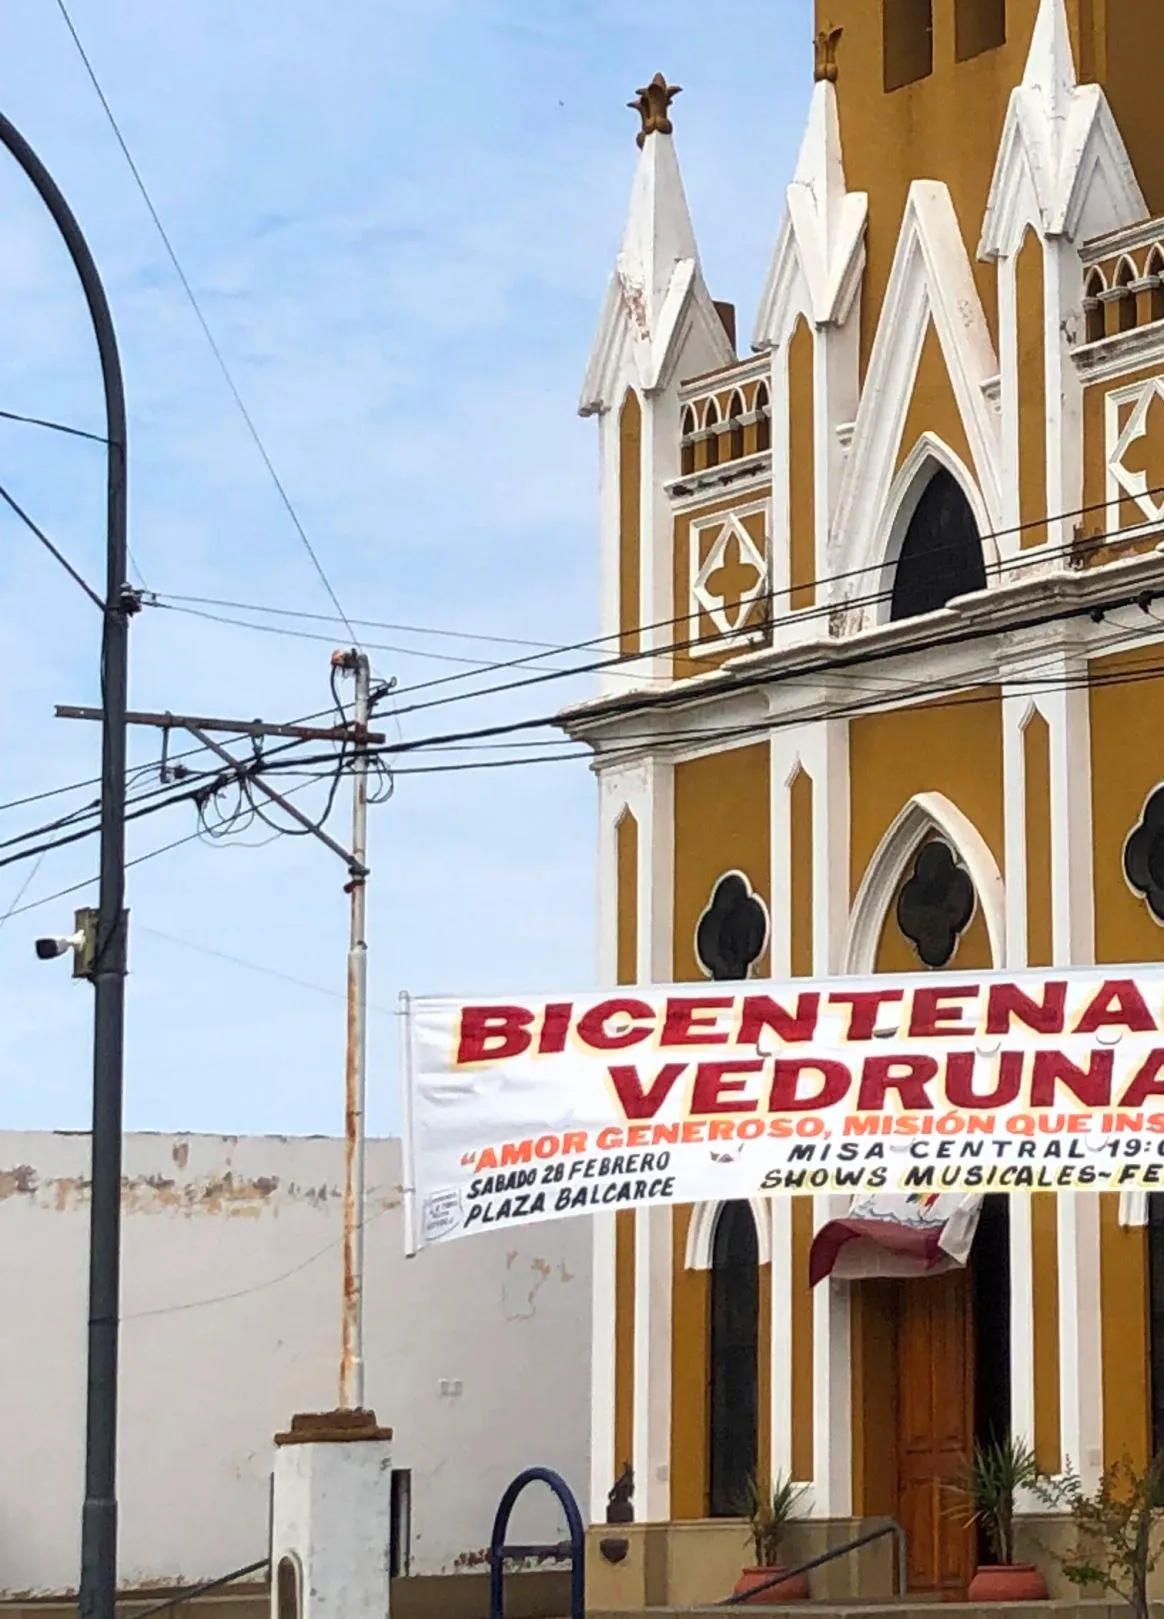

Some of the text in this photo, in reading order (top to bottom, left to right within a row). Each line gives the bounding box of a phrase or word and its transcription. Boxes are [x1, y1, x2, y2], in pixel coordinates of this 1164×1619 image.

[460, 1131, 587, 1173] “AMOR
[596, 1116, 832, 1149] GENEROSO,
[843, 1110, 994, 1136] MISIÓN
[1006, 1113, 1093, 1138] QUE
[787, 1142, 886, 1162] MISA
[910, 1139, 1085, 1159] CENTRAL
[466, 1151, 671, 1199] SABADO 28 FEBRERO
[760, 1167, 887, 1189] SHOWS
[463, 1192, 545, 1228] PLAZA
[554, 1176, 676, 1211] BALCARCE
